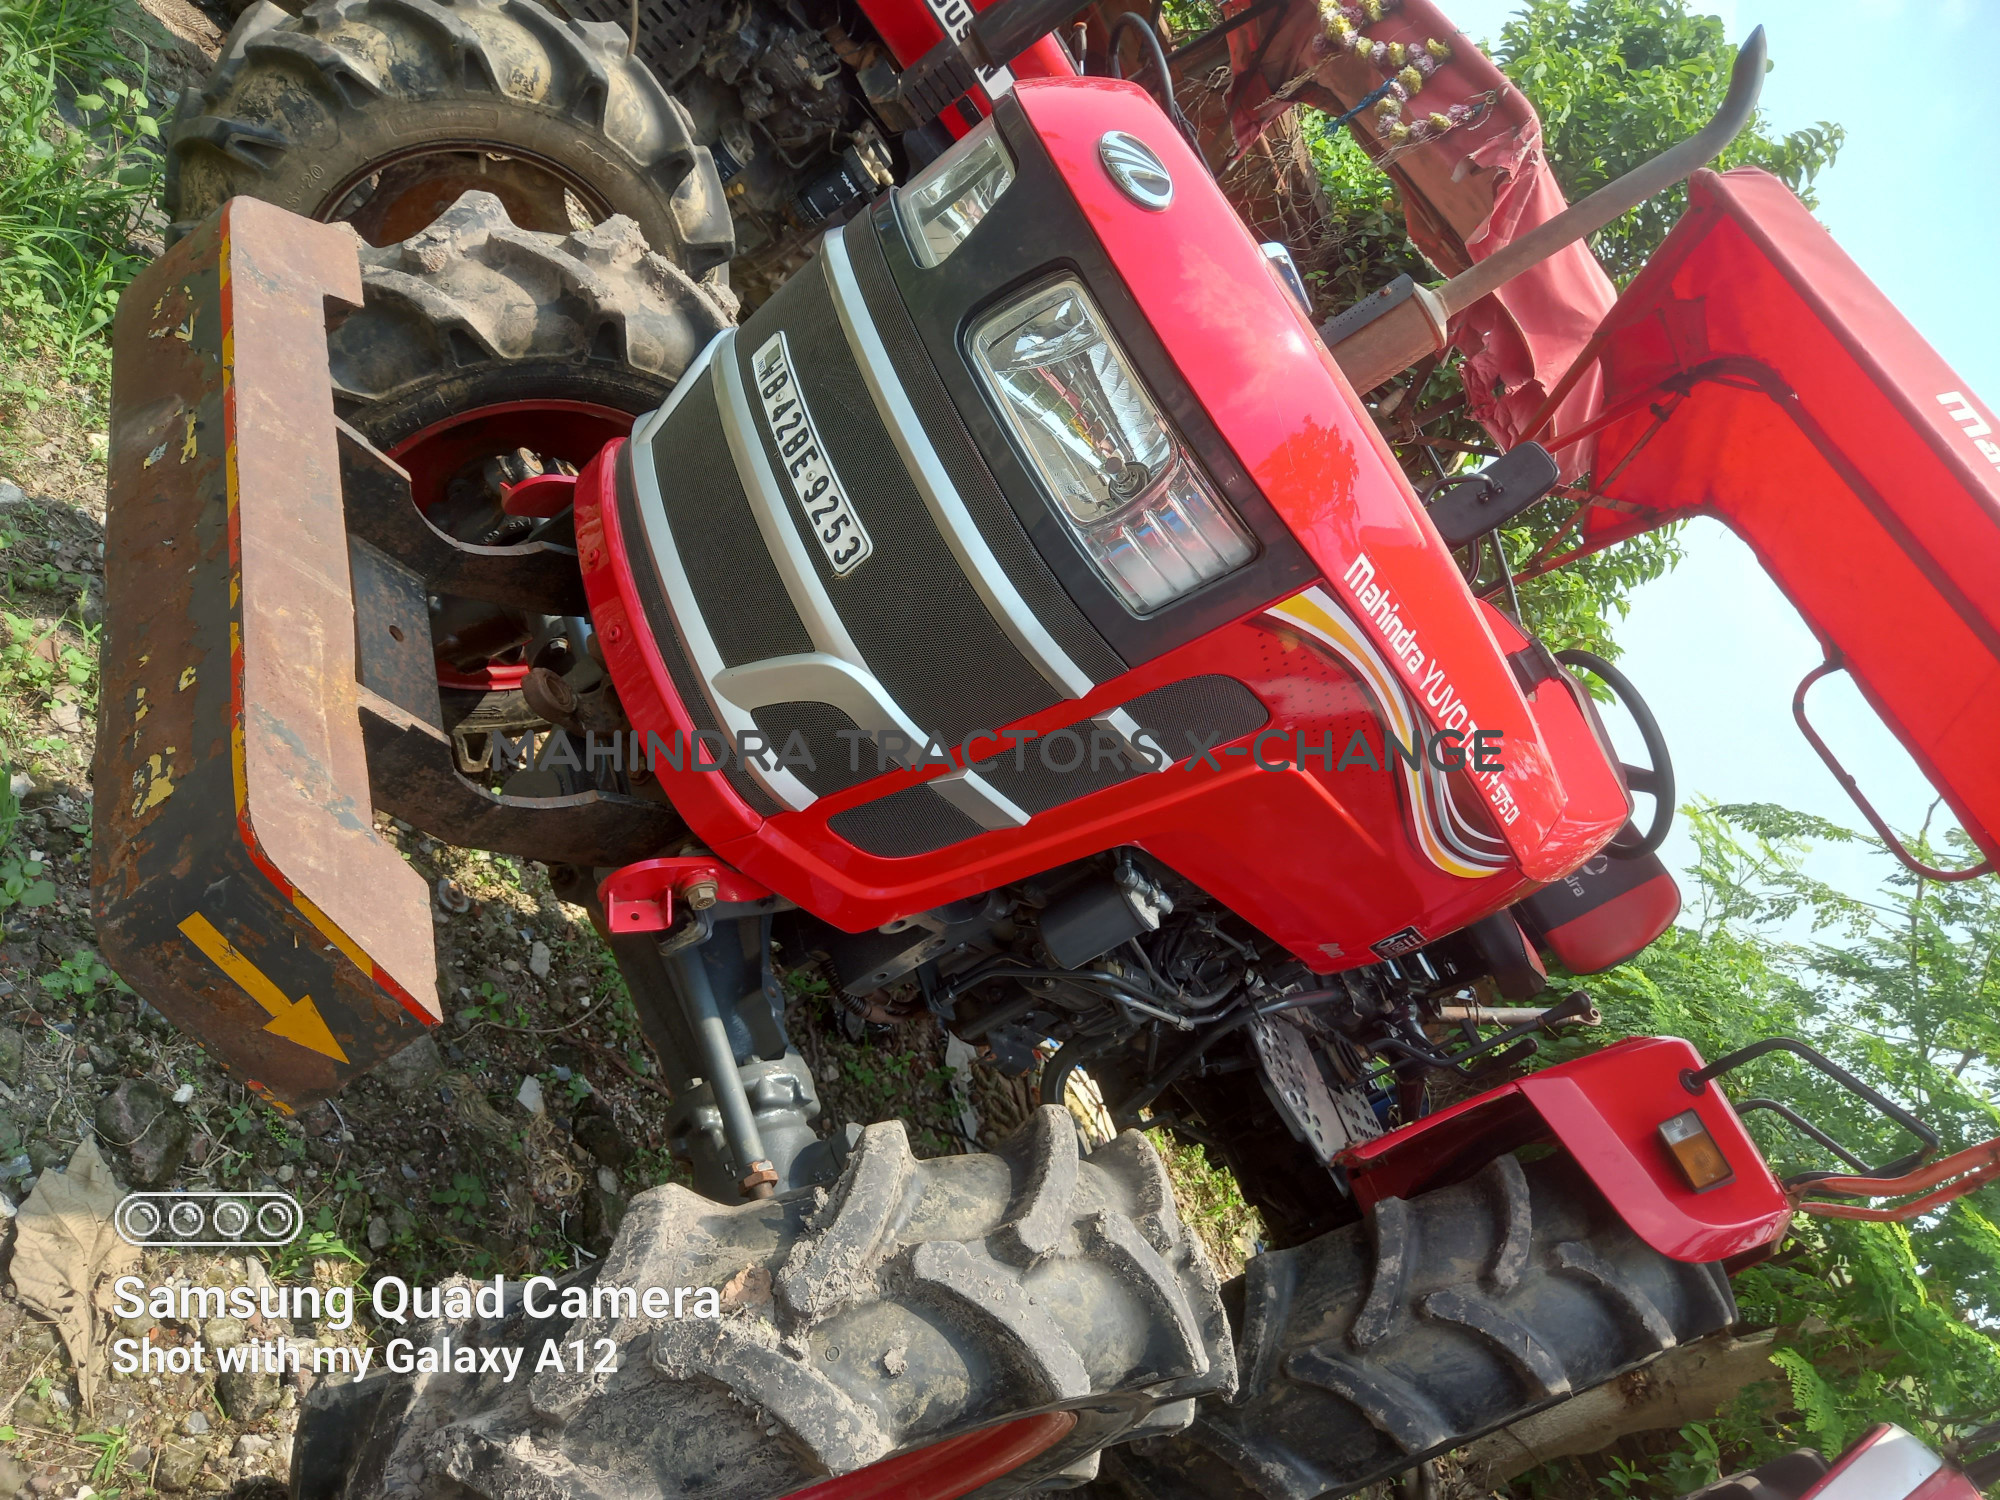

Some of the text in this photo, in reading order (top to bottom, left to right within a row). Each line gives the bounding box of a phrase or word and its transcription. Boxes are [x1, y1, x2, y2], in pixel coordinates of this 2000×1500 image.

[1936, 391, 2000, 473] Ma
[803, 475, 861, 565] 9253
[1343, 552, 1425, 675] Mahindra
[1419, 658, 1468, 733] YUVO
